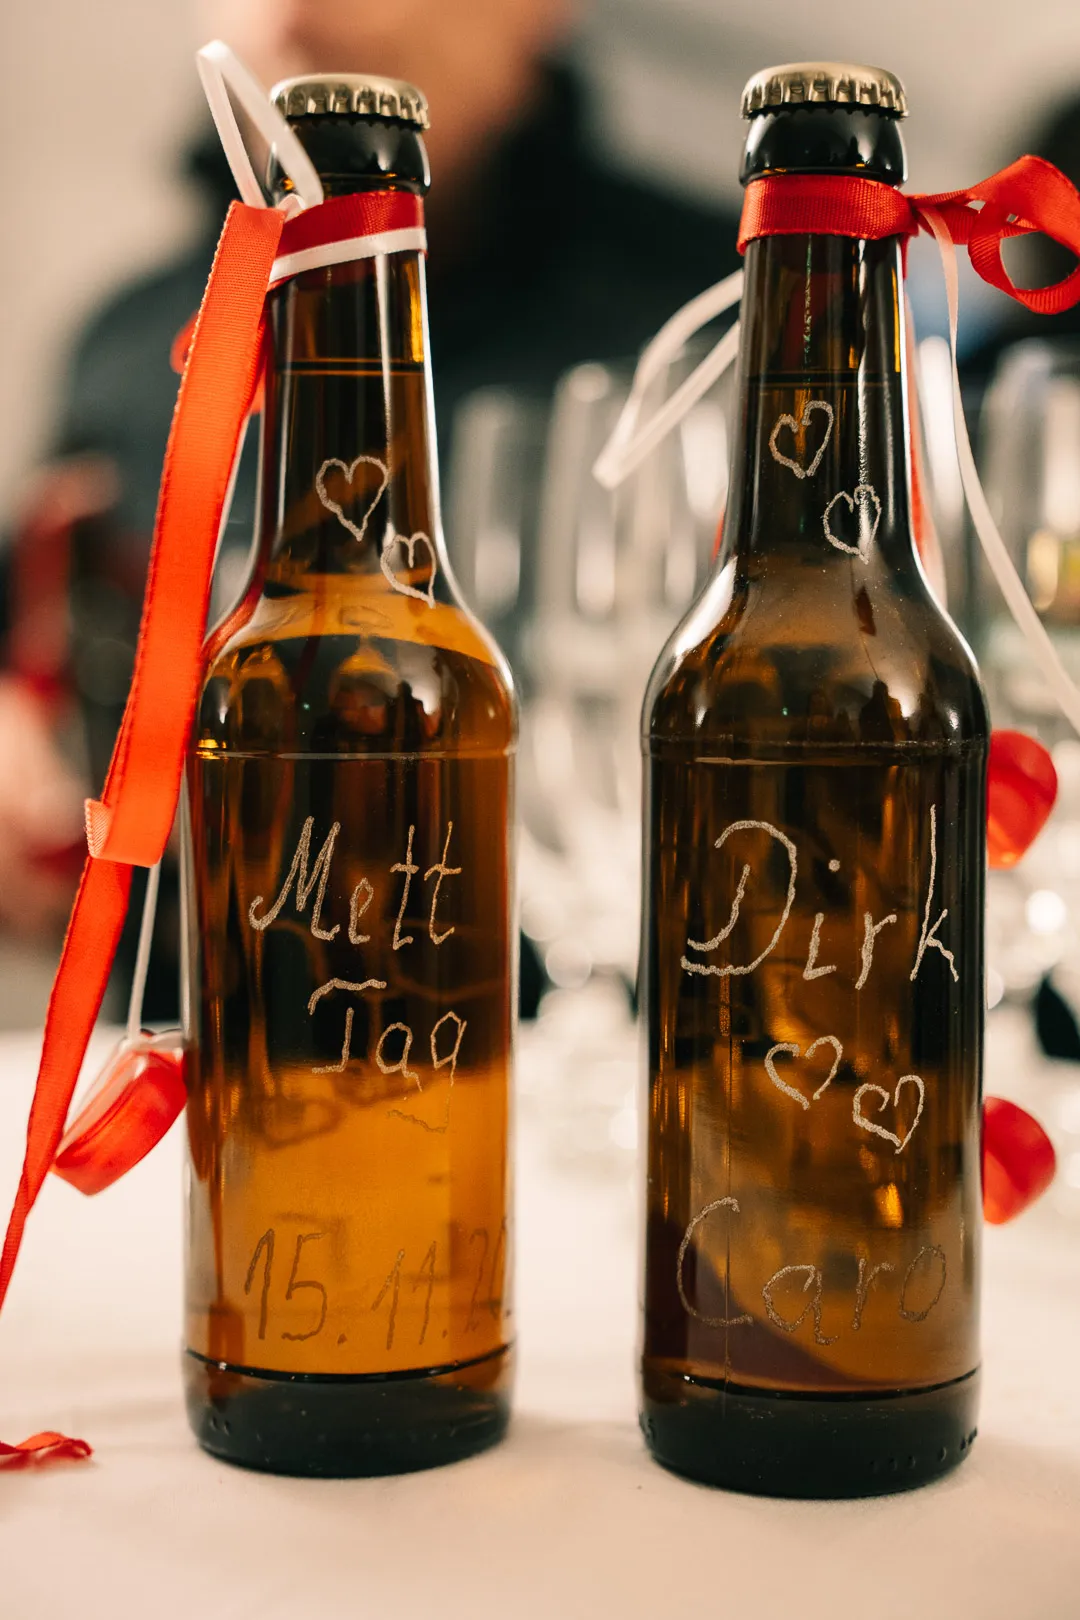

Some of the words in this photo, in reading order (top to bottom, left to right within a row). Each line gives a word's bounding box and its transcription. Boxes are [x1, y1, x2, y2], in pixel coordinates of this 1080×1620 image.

[249, 815, 462, 950] Mett
[680, 803, 959, 990] Dirk
[307, 977, 467, 1132] Tag
[676, 1196, 947, 1346] Caro
